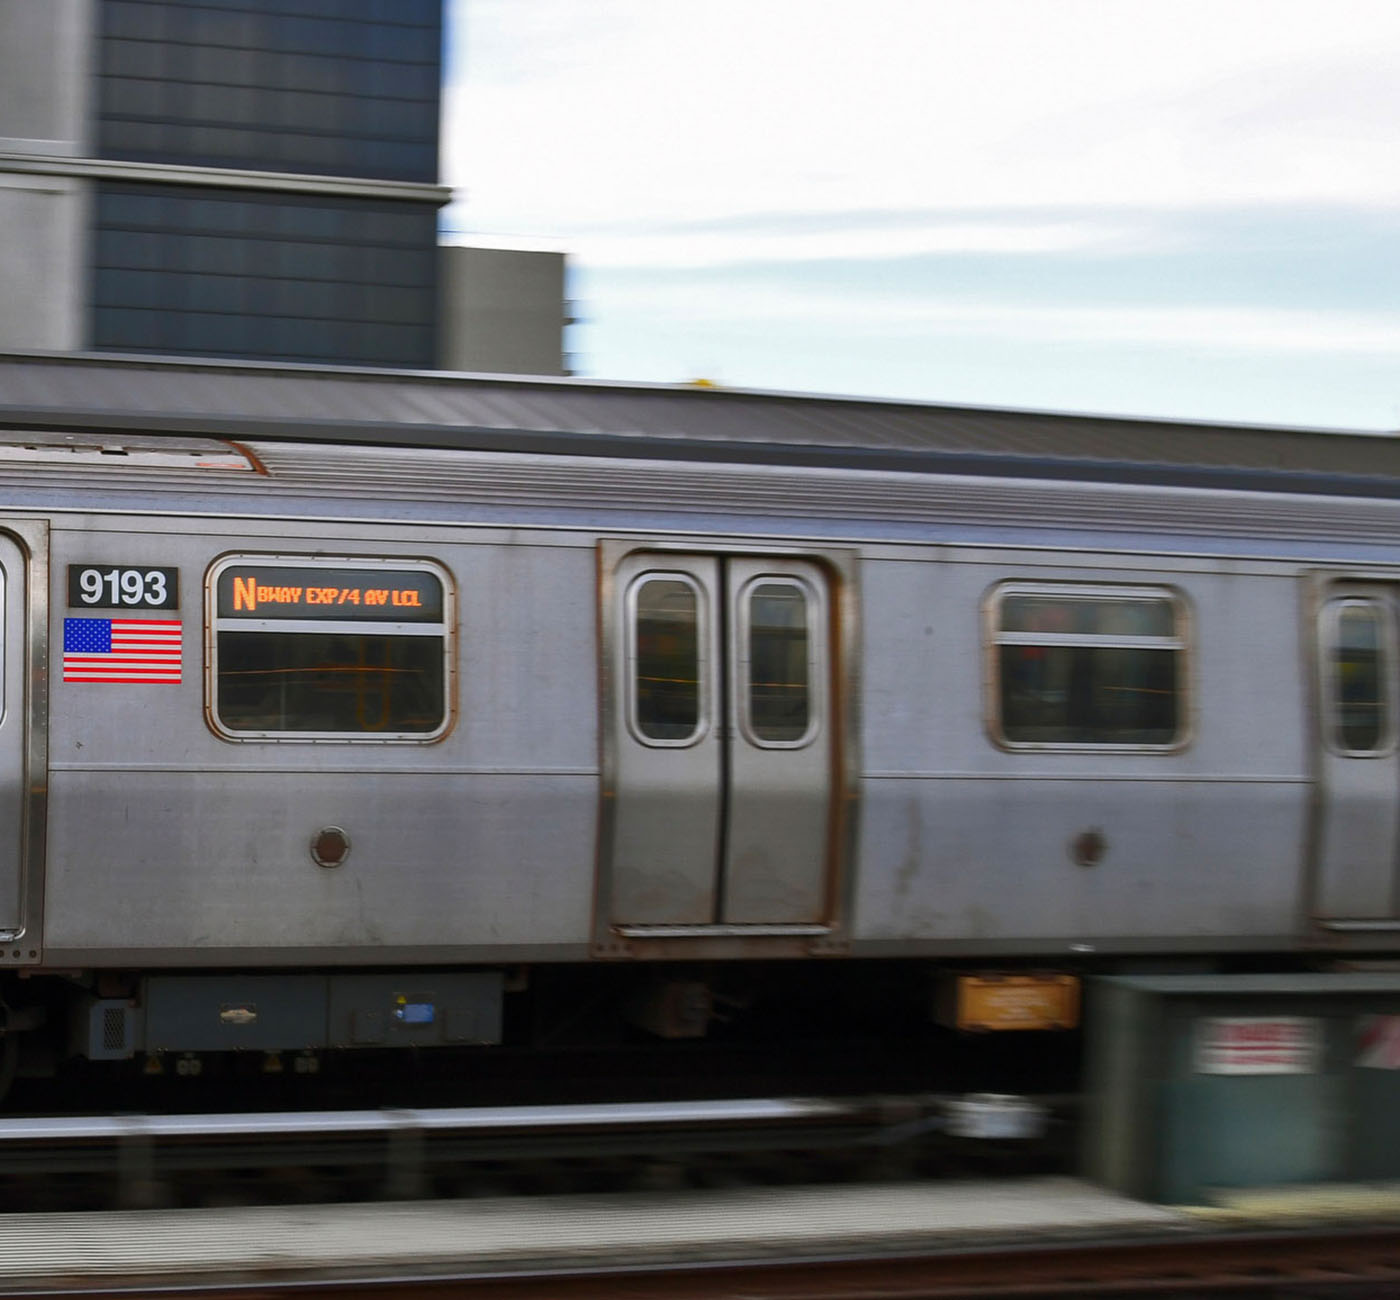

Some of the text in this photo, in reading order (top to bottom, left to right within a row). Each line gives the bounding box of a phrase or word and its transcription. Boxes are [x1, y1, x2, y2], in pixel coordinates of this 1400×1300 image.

[80, 569, 167, 605] 9193
[233, 577, 422, 611] N BWAY EXP/4 AV LCL
